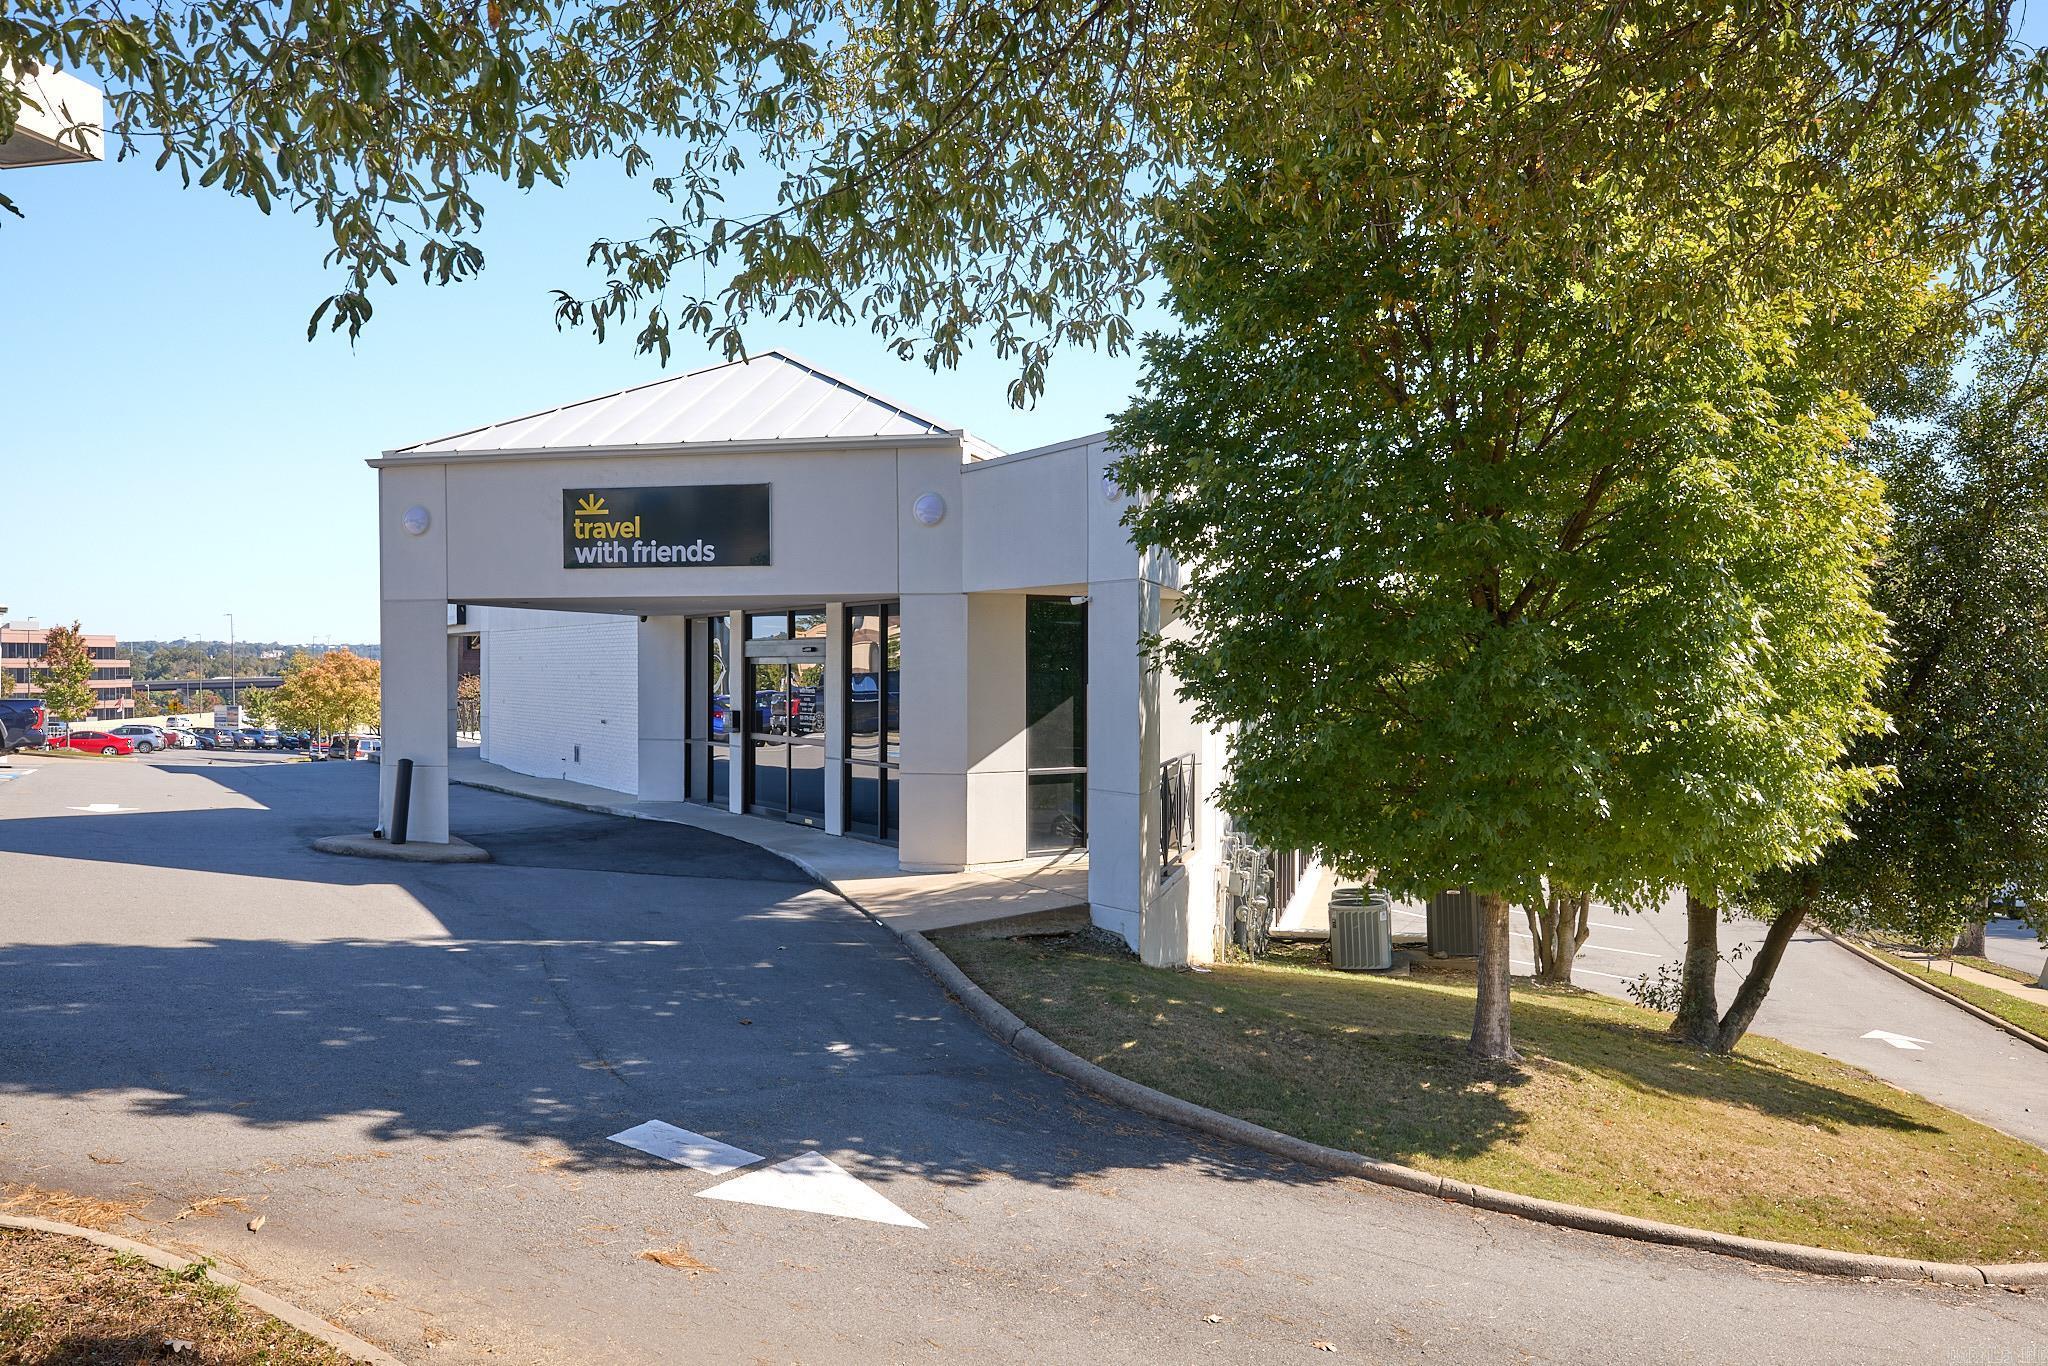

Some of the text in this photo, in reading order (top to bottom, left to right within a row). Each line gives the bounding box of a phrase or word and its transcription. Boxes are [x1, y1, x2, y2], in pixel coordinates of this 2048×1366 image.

[574, 516, 640, 539] travel
[575, 539, 715, 564] with friends
